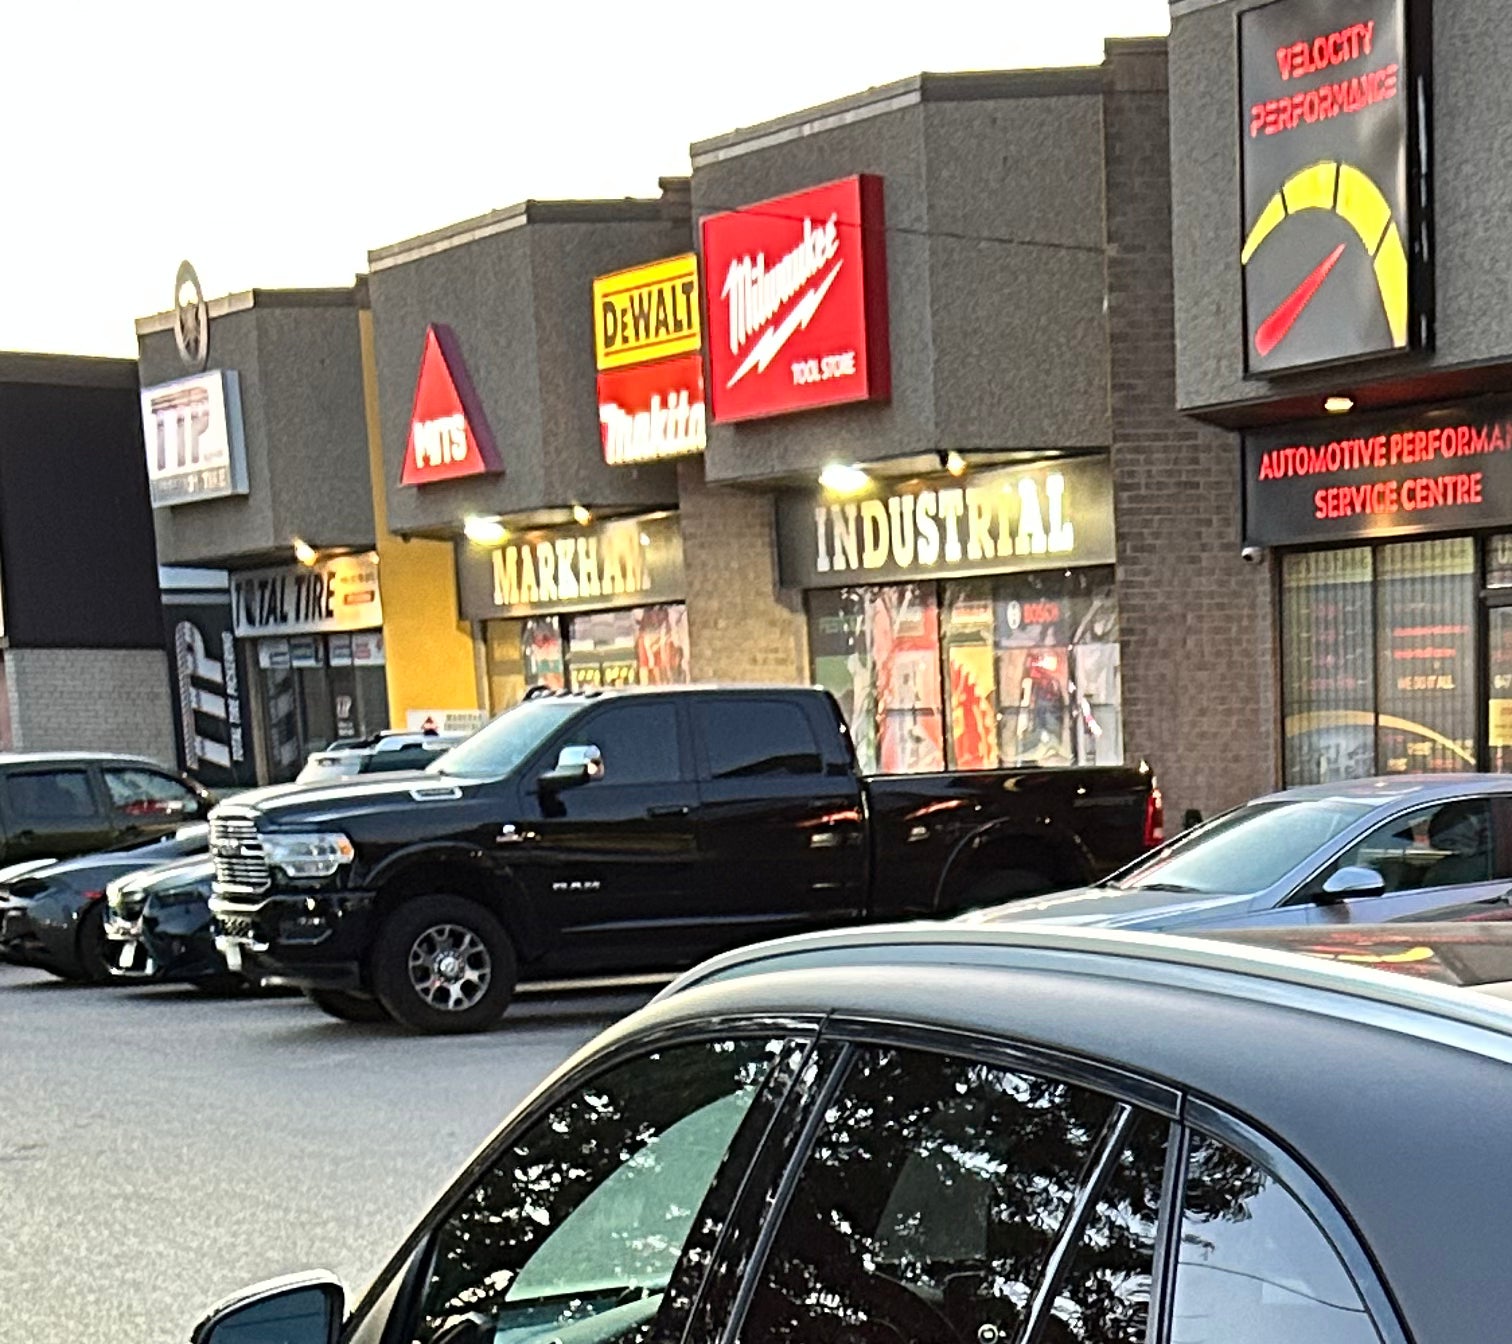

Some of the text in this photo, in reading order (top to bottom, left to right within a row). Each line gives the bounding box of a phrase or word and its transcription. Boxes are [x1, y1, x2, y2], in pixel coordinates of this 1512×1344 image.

[1276, 20, 1375, 81] VELOCITY
[1250, 63, 1399, 138] PERFORMANCE
[720, 212, 840, 356] Milwaukee
[791, 351, 856, 385] TOOL STORE
[413, 413, 468, 469] MITS
[1259, 435, 1387, 481] AUTOMOTIVE
[815, 472, 1074, 572] INDUSTRIAL
[1314, 472, 1483, 520] SERVICE CENTRE
[236, 571, 337, 628] TOTAL TIRE
[492, 535, 651, 605] MARKHAM
